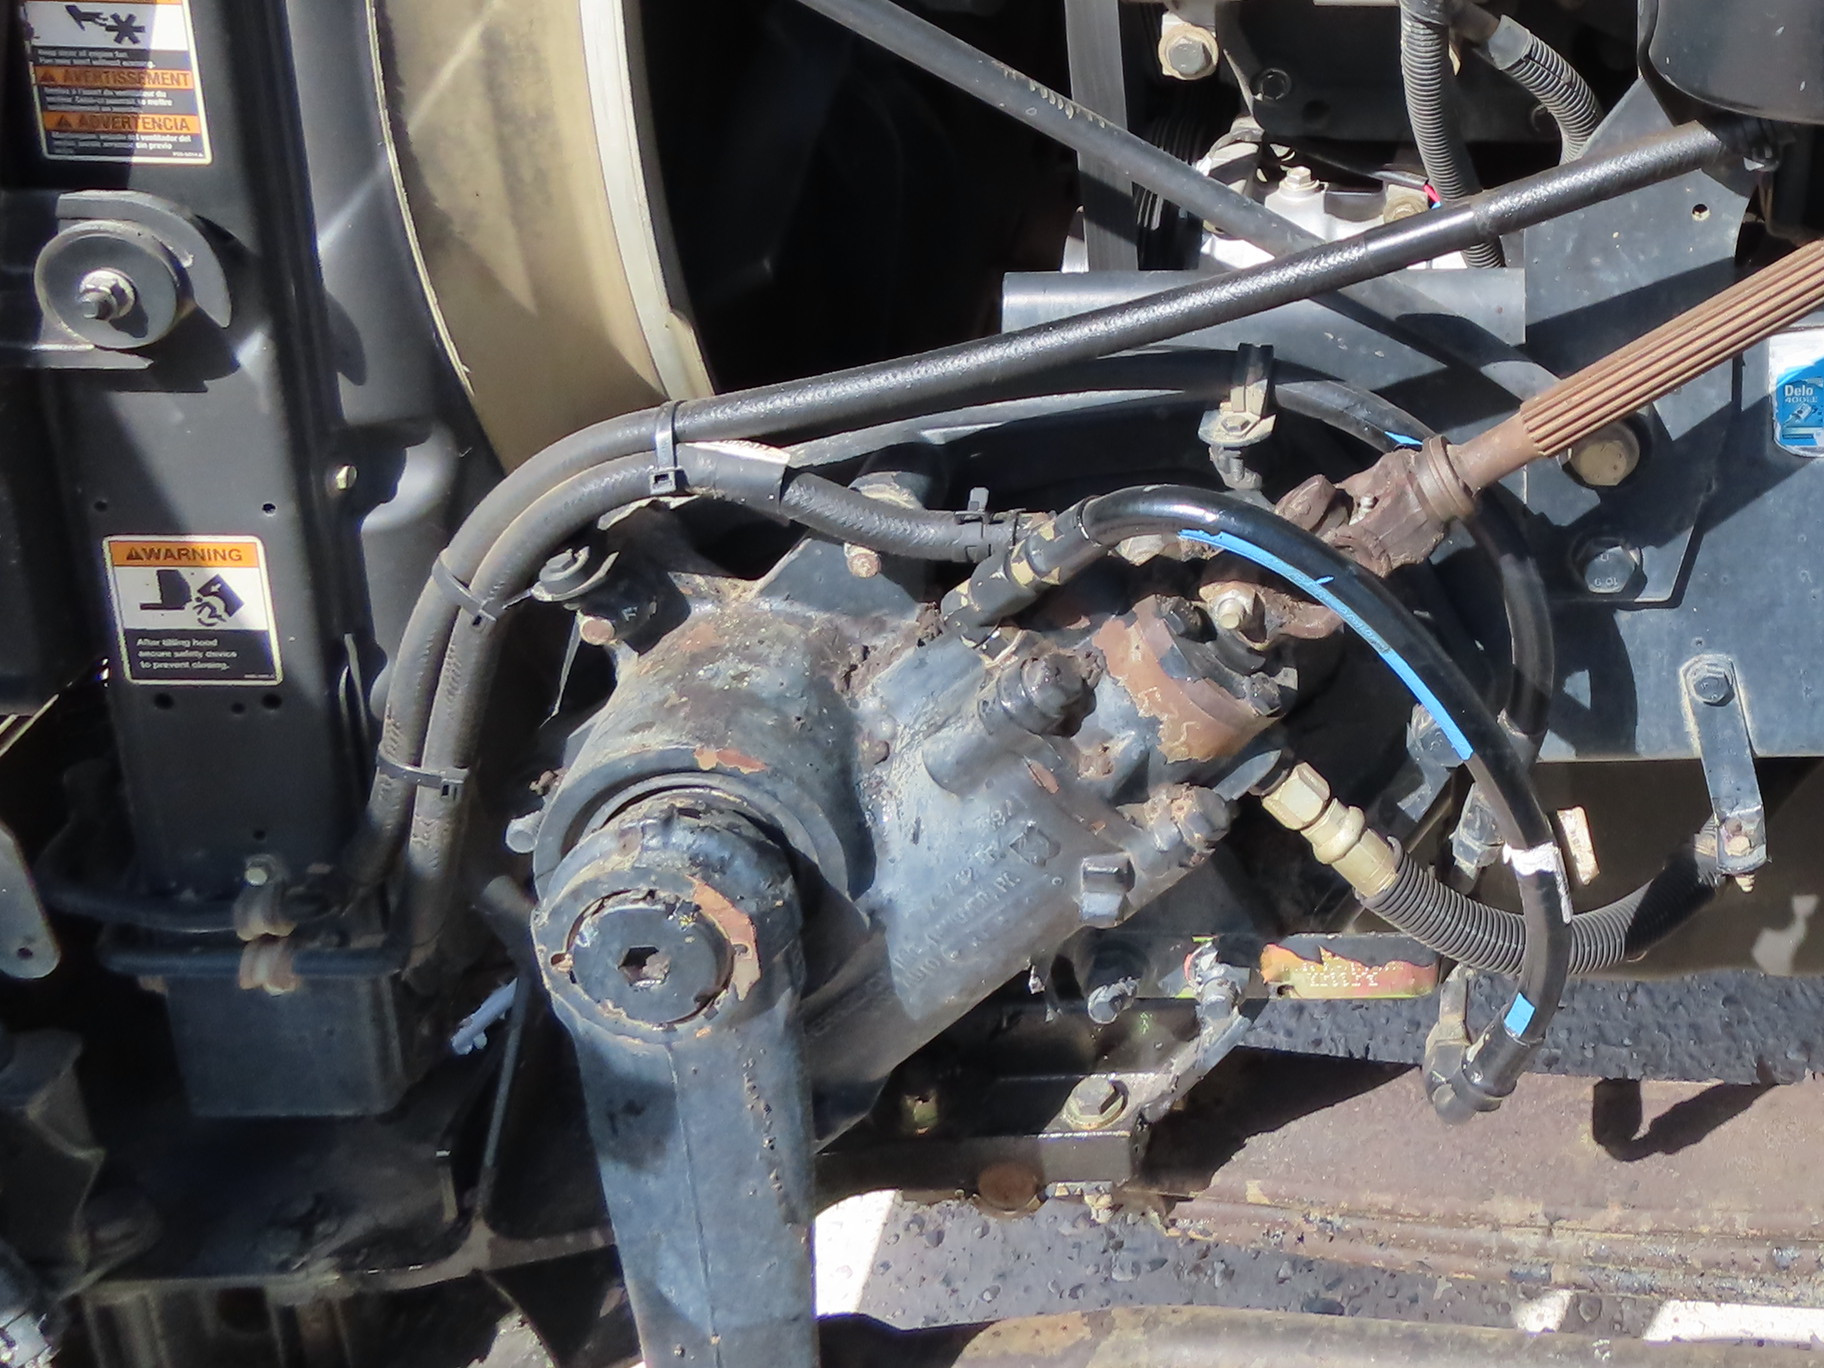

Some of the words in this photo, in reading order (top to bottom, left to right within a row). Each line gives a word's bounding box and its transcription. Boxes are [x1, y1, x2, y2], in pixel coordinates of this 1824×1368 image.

[63, 70, 190, 87] AVERTISSEMENT
[78, 115, 191, 132] ADVERTENCIA
[1784, 384, 1814, 396] Delo
[141, 547, 243, 562] WARNING
[137, 639, 160, 647] After
[192, 638, 219, 647] hood
[173, 650, 204, 659] safety
[205, 651, 238, 659] device
[139, 661, 152, 669] to
[153, 662, 191, 670] prevent
